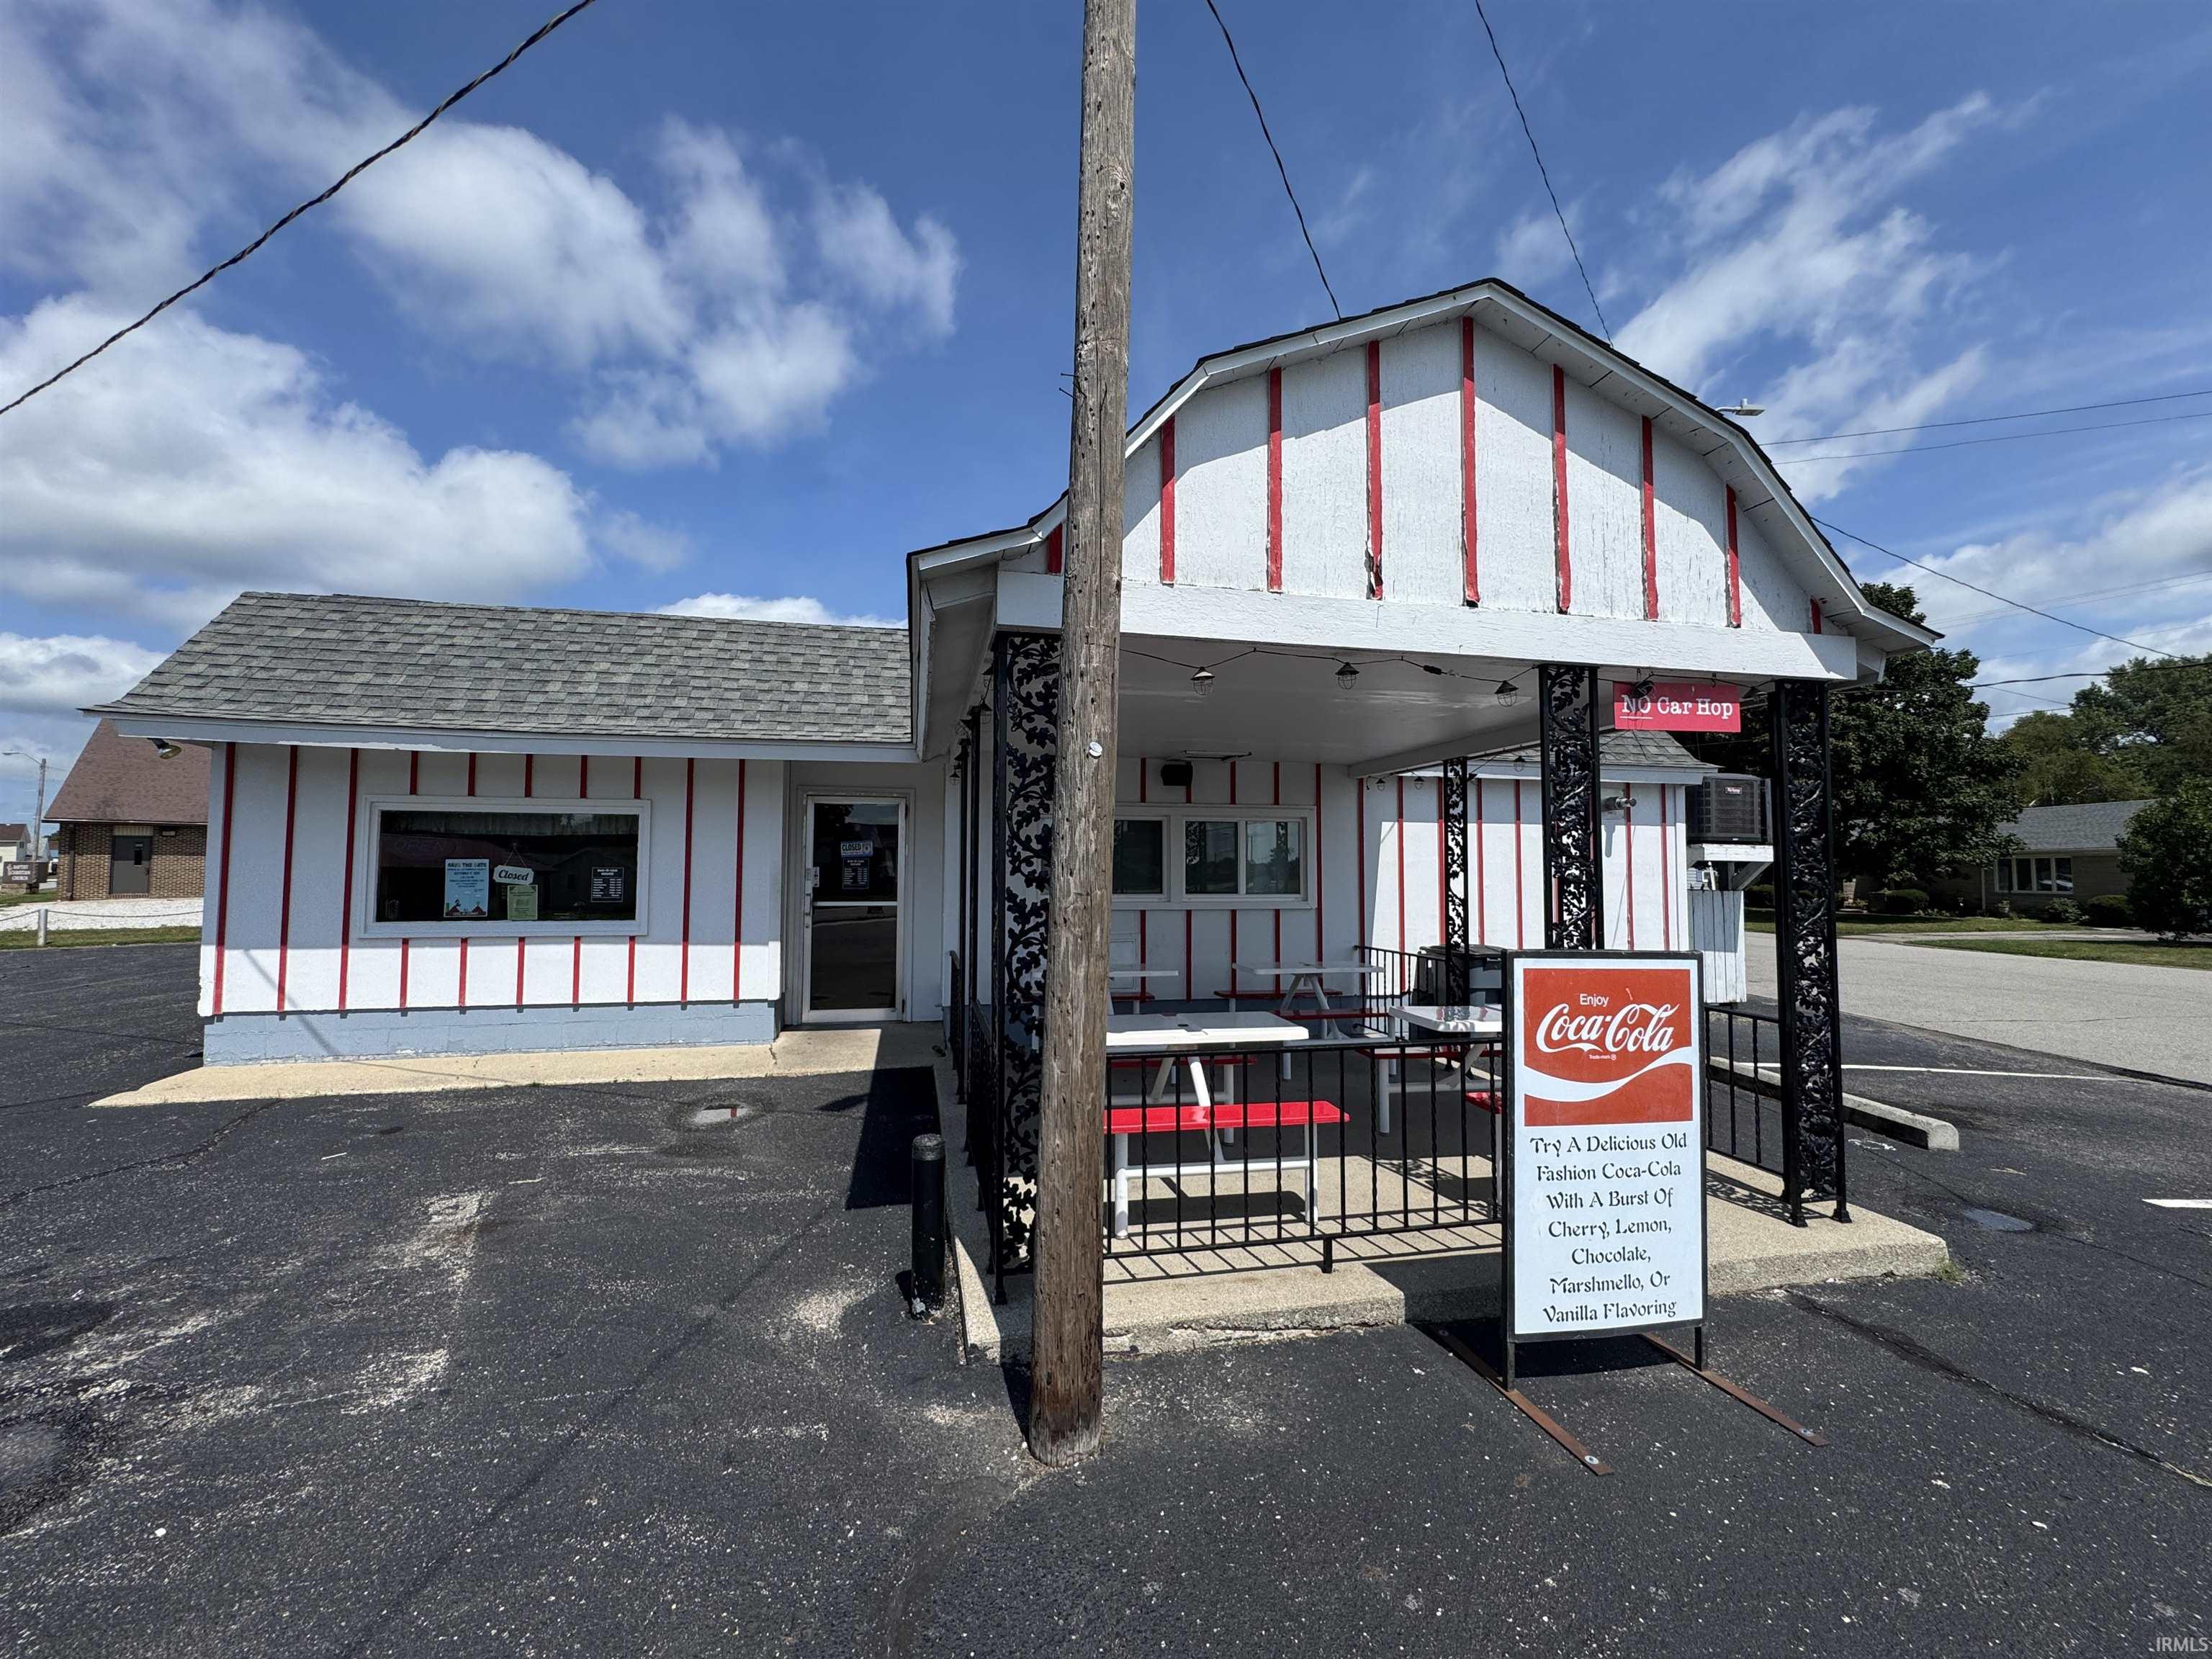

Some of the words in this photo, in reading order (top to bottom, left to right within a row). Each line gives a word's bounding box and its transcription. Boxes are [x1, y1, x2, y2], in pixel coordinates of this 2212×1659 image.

[1621, 695, 1651, 714] NO
[1657, 696, 1692, 715] Car
[1695, 698, 1733, 719] Hop
[498, 869, 530, 881] Closed
[1579, 993, 1609, 1007] Enjoy
[1536, 1003, 1680, 1053] Coca-Cola
[1529, 1136, 1562, 1158] Try
[1567, 1136, 1581, 1153] A
[1586, 1135, 1656, 1152] Delicious
[1661, 1132, 1687, 1149] Old
[1537, 1164, 1596, 1182] Fashion
[1602, 1160, 1681, 1179] Coca-Cola
[1545, 1191, 1583, 1210] With
[1588, 1192, 1604, 1208] A
[1609, 1190, 1649, 1207] Burst
[1653, 1187, 1673, 1208] Of
[1548, 1220, 1610, 1240] Cherry,
[1615, 1218, 1672, 1234] Lemon,
[1571, 1246, 1651, 1265] Chocolate,
[1550, 1273, 1644, 1295] Marshmello,
[1650, 1270, 1671, 1287] Or
[1542, 1305, 1598, 1323] Vanilla
[1603, 1299, 1677, 1320] Flavoring
